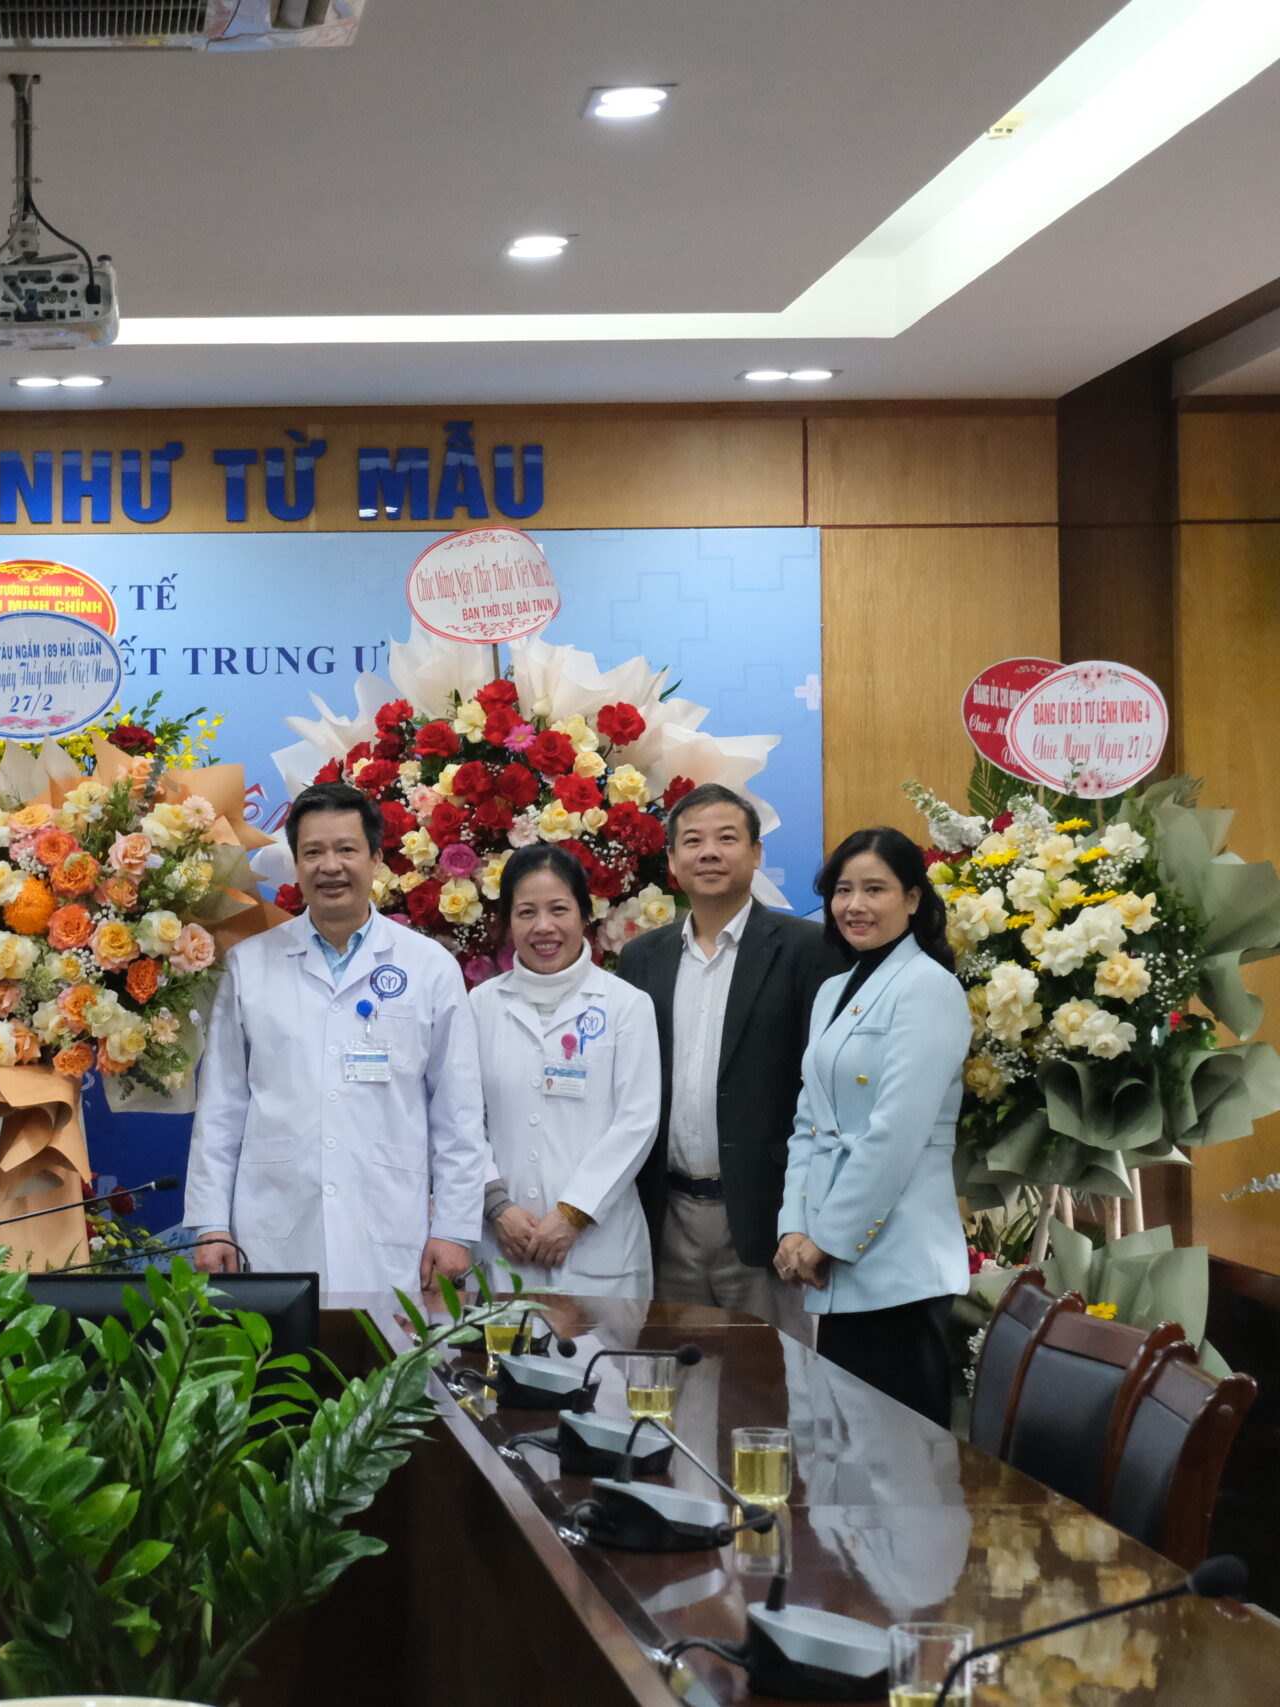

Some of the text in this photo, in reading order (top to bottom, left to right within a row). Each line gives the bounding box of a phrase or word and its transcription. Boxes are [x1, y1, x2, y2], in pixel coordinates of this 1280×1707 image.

[213, 429, 328, 522] TỪ
[357, 421, 544, 521] MẪU
[0, 582, 30, 597] TƯỚNG
[33, 583, 62, 597] CHÍNH
[65, 582, 84, 597] PHỦ
[129, 573, 178, 611] TẾ
[54, 597, 103, 613] CHÍNH
[462, 606, 480, 621] BAN
[532, 598, 553, 612] TNVN
[43, 643, 57, 658] 189
[60, 637, 75, 656] HẢI
[78, 639, 102, 656] QUÂN
[92, 660, 113, 683] Nam
[182, 645, 336, 675] TRUNG
[9, 692, 53, 716] 27/2
[1033, 695, 1056, 725] ĐẢNG
[1058, 695, 1069, 724] ỦY
[1071, 697, 1082, 729] BỘ
[1084, 699, 1095, 723] TƯ
[1097, 696, 1117, 729] LỆNH
[1121, 695, 1142, 723] VÙNG
[1145, 700, 1150, 723] 4
[1033, 733, 1057, 760] Chúc
[1062, 733, 1091, 766] Mừng
[1094, 732, 1124, 766] Ngày
[1127, 732, 1153, 766] 27/2
